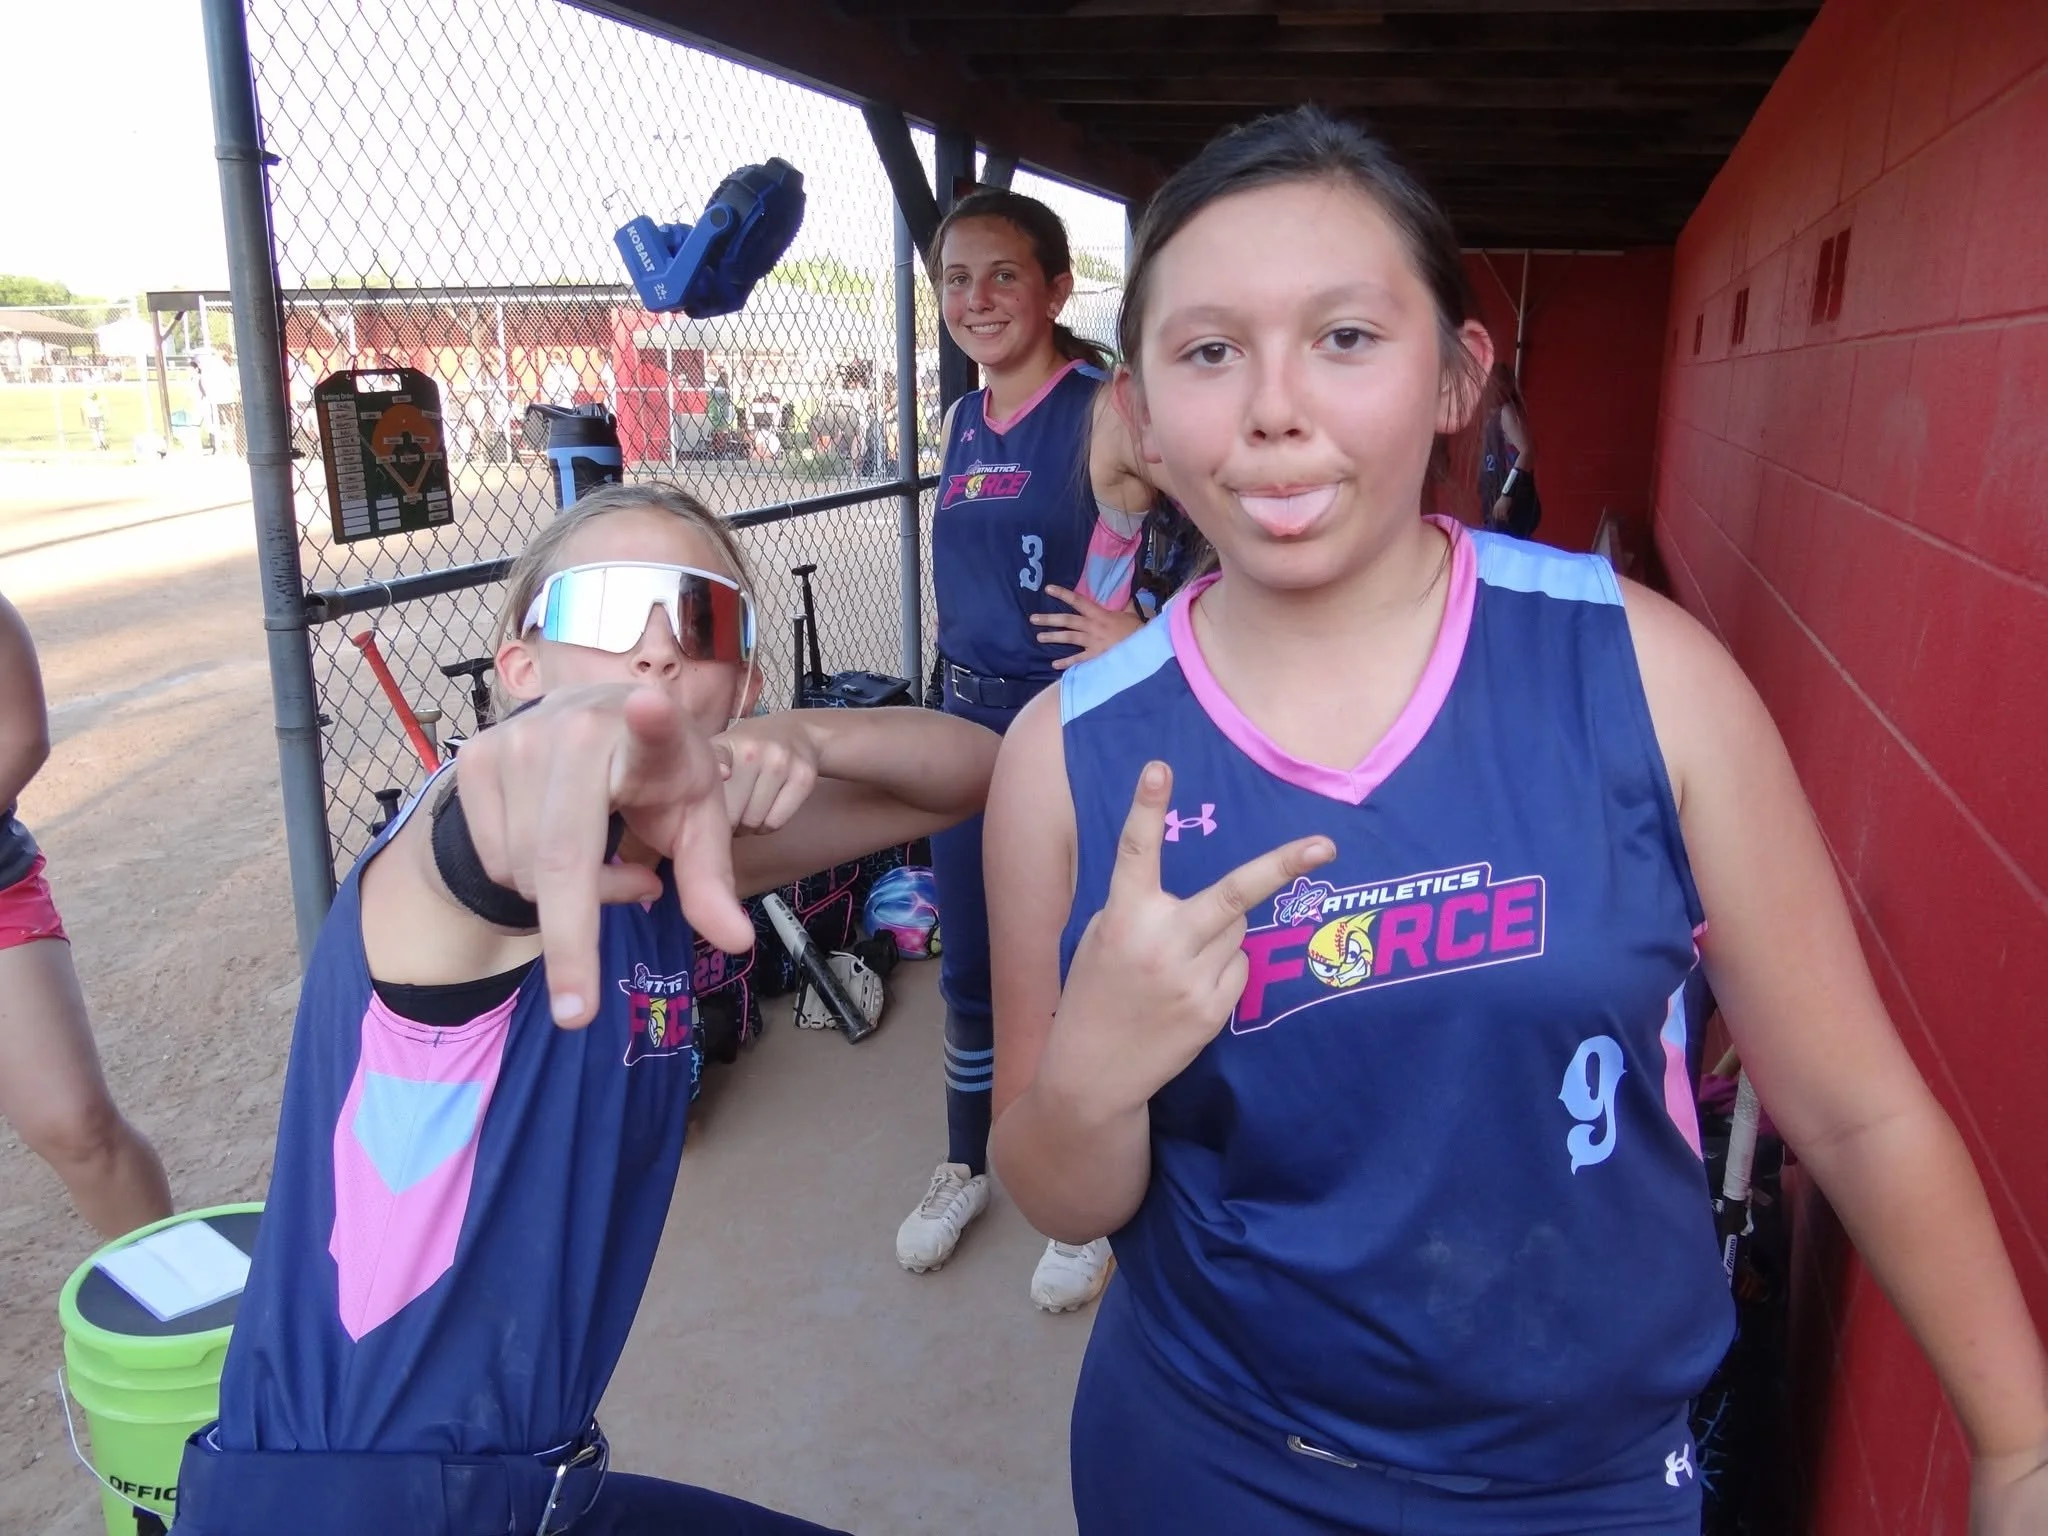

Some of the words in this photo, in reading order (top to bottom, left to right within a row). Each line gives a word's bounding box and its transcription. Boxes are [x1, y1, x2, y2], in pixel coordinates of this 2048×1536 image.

[627, 226, 656, 272] KOBALT
[976, 465, 1017, 474] ATHLETICS
[1019, 534, 1044, 592] 3
[1321, 869, 1481, 914] ATHLETICS
[1558, 1035, 1627, 1175] 9
